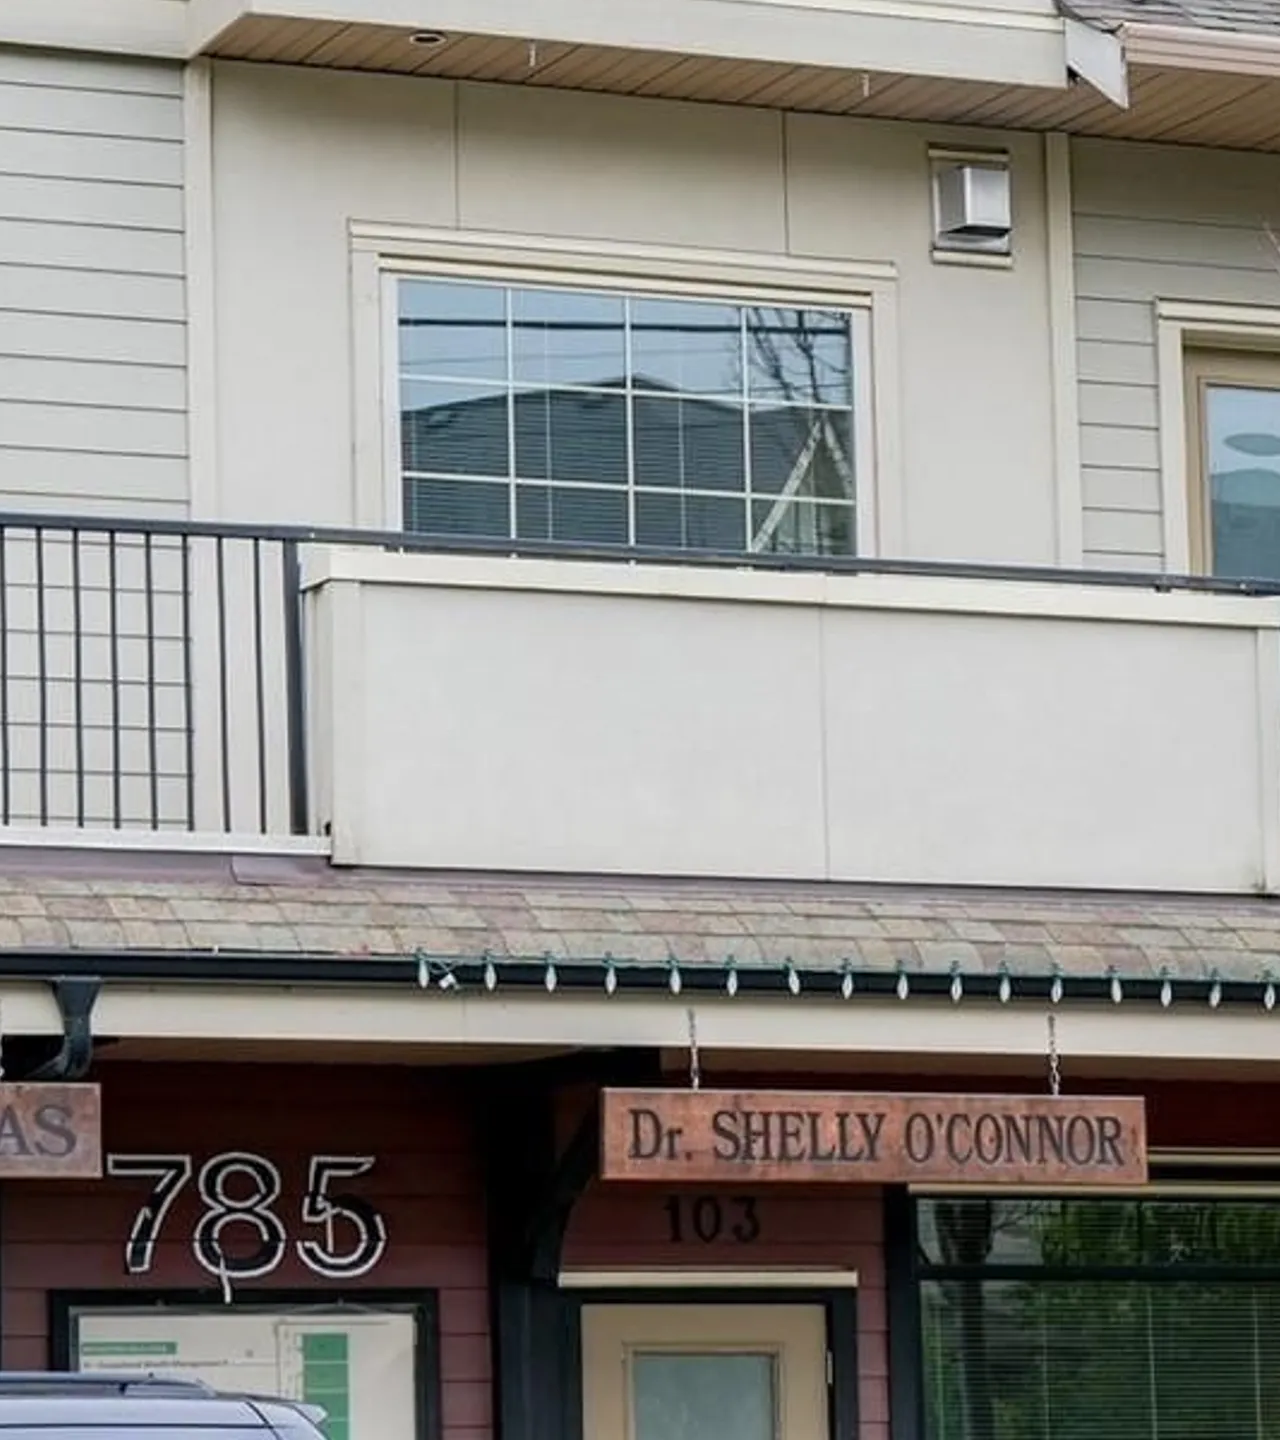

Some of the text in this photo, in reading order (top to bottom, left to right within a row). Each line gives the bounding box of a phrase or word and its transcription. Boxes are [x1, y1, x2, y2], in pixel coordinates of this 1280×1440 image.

[627, 1107, 1126, 1166] Dr. SHELLY O'CONNOR
[106, 1151, 387, 1280] 785
[663, 1194, 761, 1244] 103
